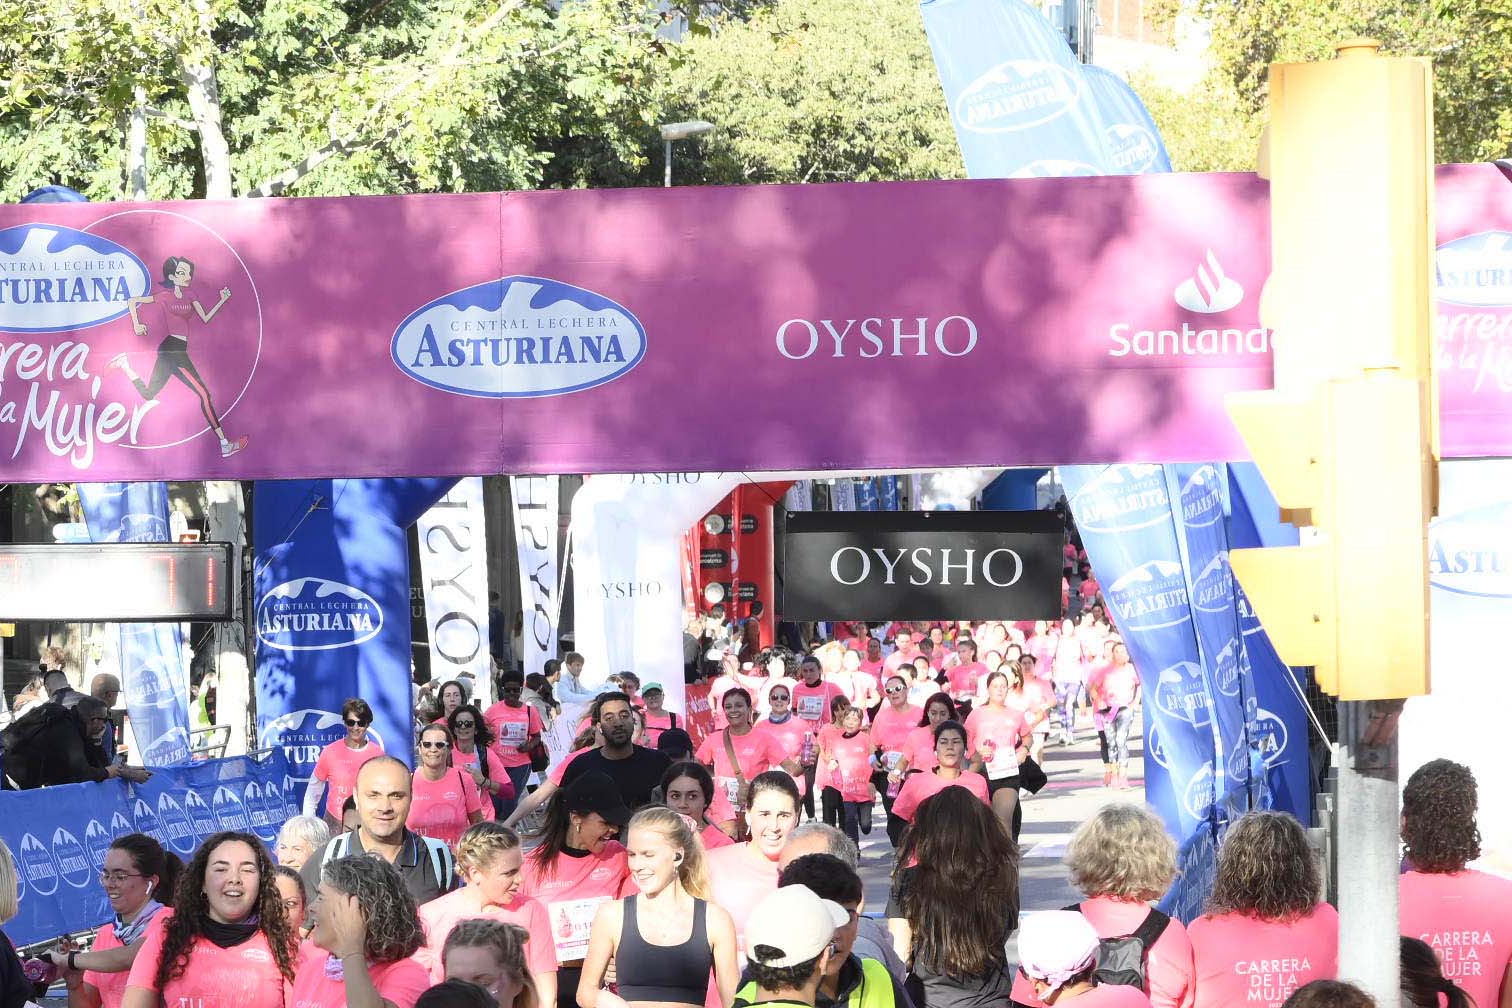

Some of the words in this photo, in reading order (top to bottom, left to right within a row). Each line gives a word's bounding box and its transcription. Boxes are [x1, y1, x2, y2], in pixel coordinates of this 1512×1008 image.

[54, 258, 126, 272] LECHERA
[450, 318, 530, 332] CENTRAL
[537, 316, 619, 330] LECHERA
[411, 324, 627, 369] ASTURIANA
[775, 314, 979, 360] OYSHO
[1108, 319, 1279, 358] Santand
[11, 375, 161, 470] Mujer
[830, 546, 1024, 588] OYSHO
[273, 602, 316, 611] CENTRAL
[320, 601, 370, 611] LECHERA
[261, 606, 374, 634] ASTURIANA
[1234, 956, 1312, 975] CARRERA
[1459, 947, 1479, 961] LA
[1251, 973, 1272, 988] DE
[1278, 973, 1298, 987] LA
